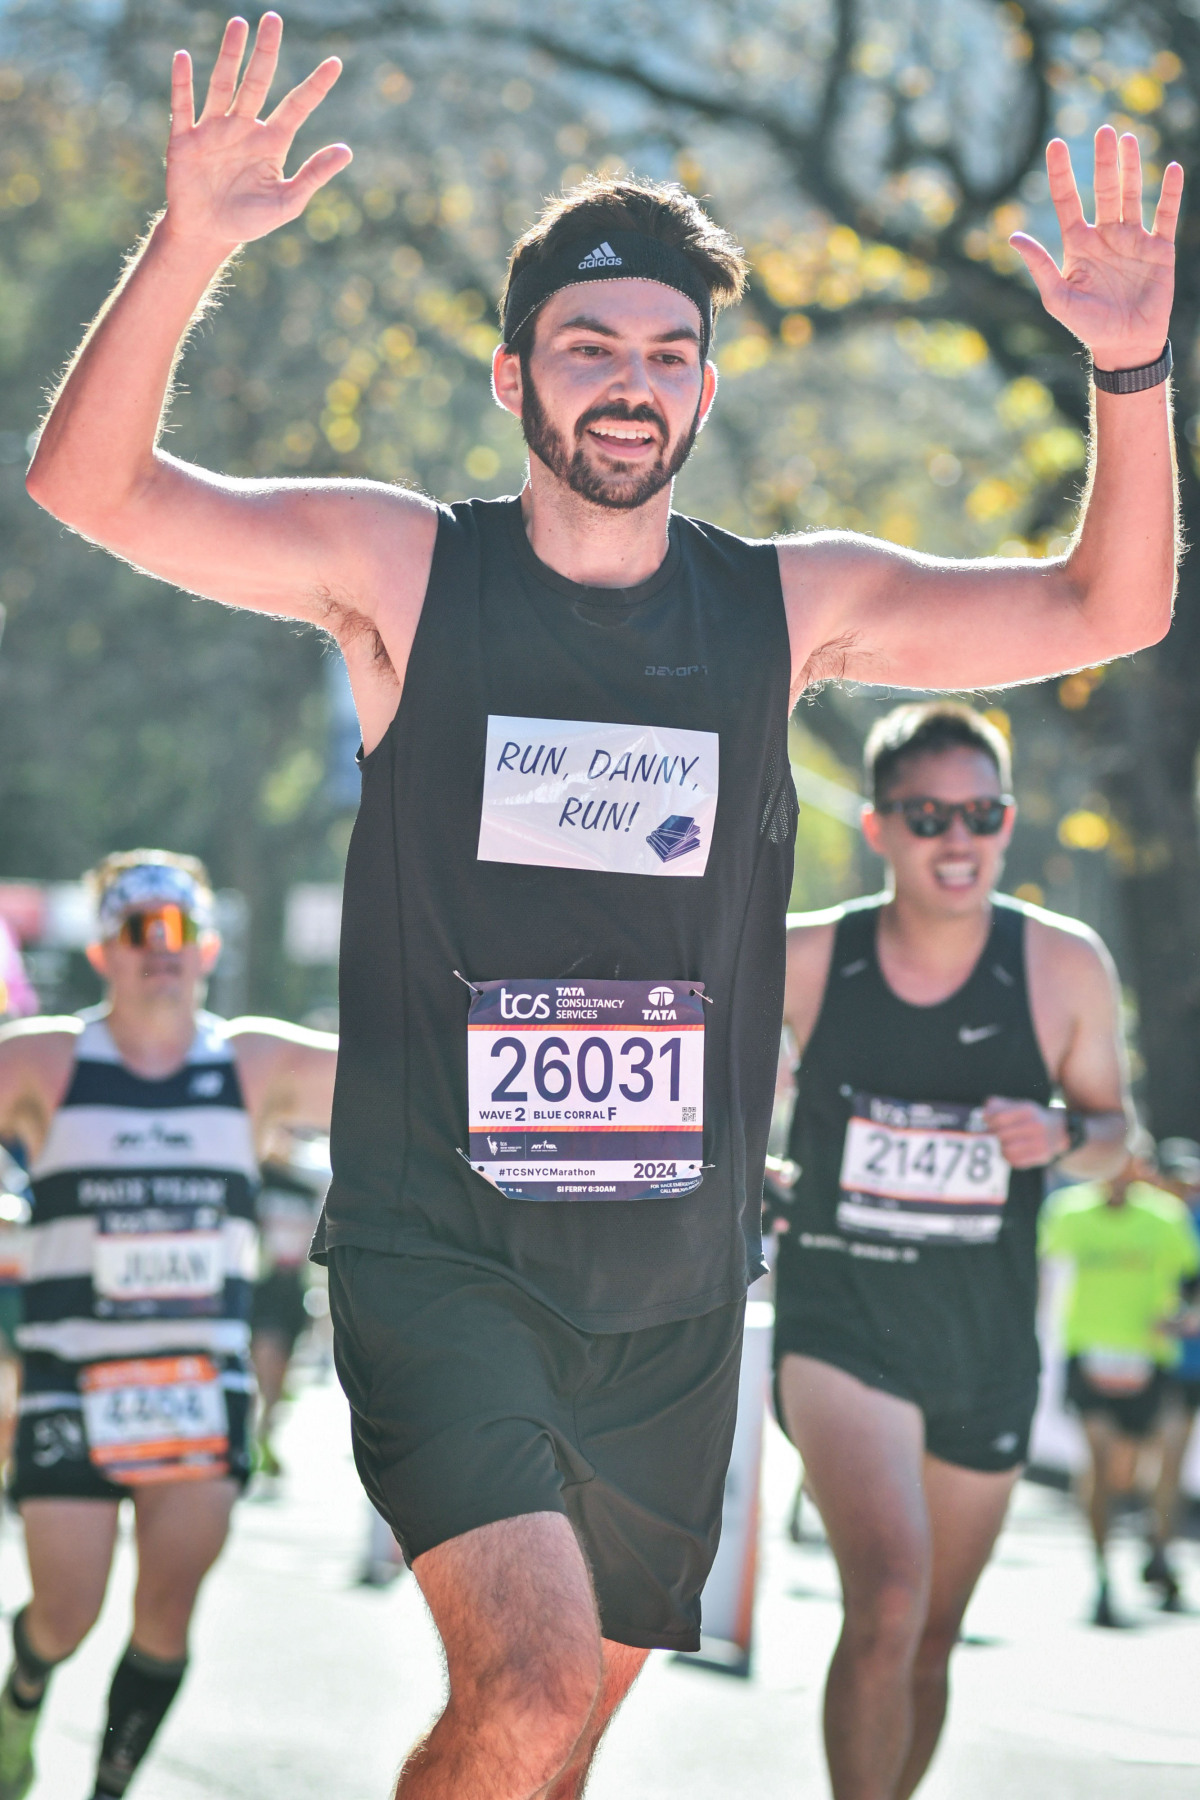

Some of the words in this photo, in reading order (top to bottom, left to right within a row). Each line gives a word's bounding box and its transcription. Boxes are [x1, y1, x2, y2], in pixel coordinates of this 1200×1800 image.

[578, 257, 622, 269] adidas
[497, 741, 568, 781] RUN,
[587, 749, 700, 790] DANNY,
[558, 797, 640, 832] RUN!
[556, 987, 585, 996] TATA
[500, 987, 550, 1019] tcs
[556, 999, 625, 1009] CONSULTANCY
[556, 1010, 598, 1019] SERVICES
[642, 1009, 677, 1020] TATA
[490, 1036, 682, 1103] 26031
[479, 1110, 512, 1120] WAVE
[514, 1107, 527, 1122] 2
[533, 1110, 562, 1120] BLUE
[564, 1110, 606, 1120] CORRAL
[608, 1107, 617, 1121] F
[865, 1132, 993, 1184] 21478
[499, 1168, 596, 1177] #TCSNYCMarathon
[633, 1163, 677, 1178] 2024
